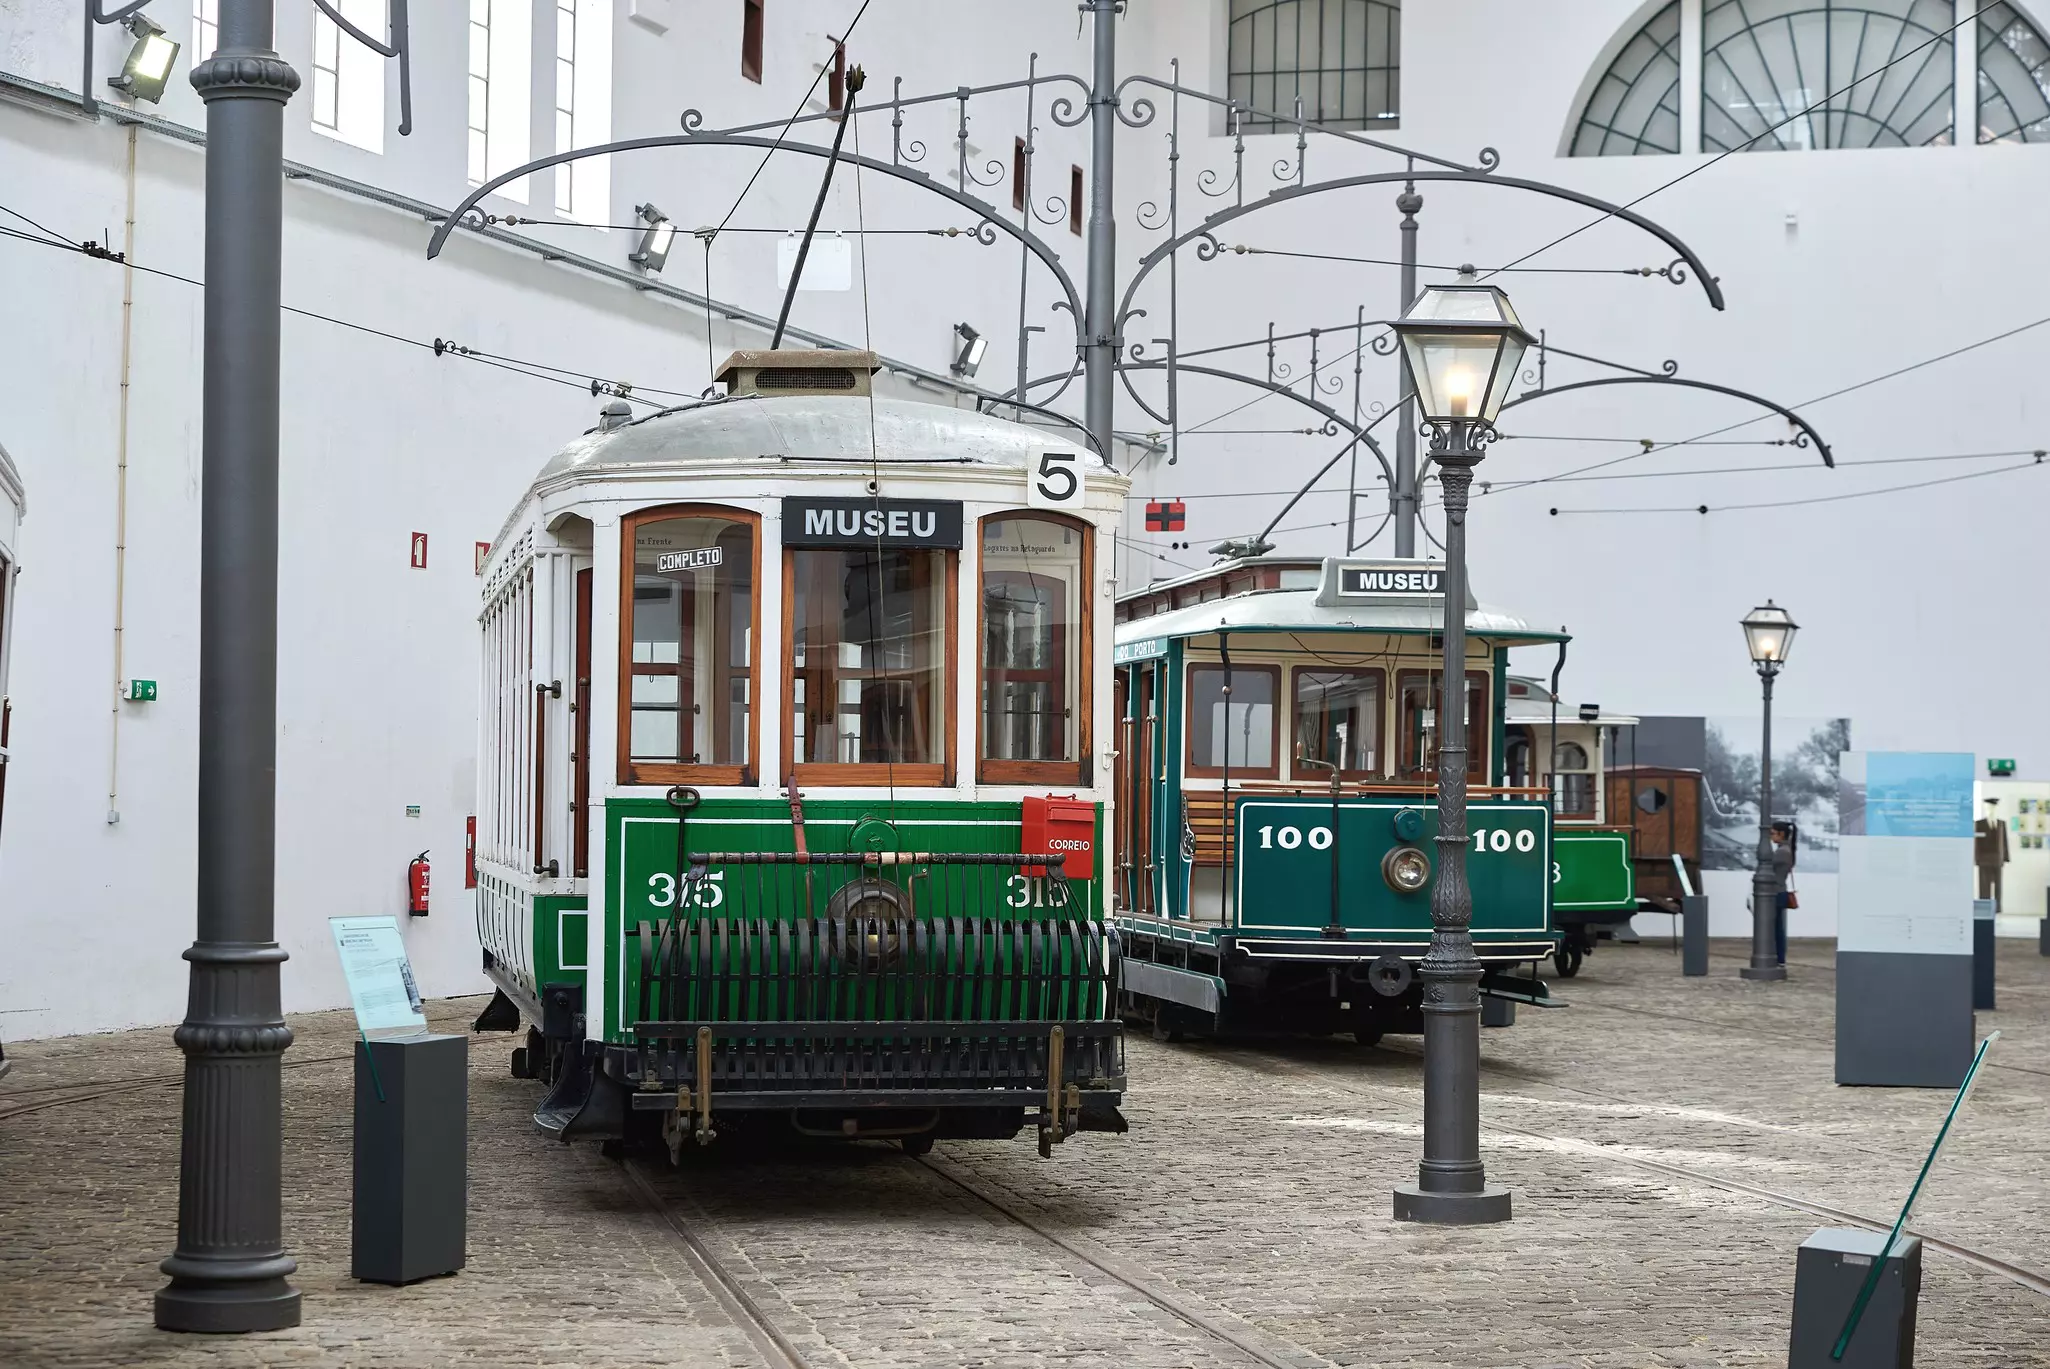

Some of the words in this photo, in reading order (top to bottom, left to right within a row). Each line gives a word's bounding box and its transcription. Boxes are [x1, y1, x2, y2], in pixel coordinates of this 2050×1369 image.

[1036, 453, 1077, 501] 5
[804, 509, 936, 537] MUSEU
[659, 548, 720, 570] COMPLETO
[1360, 572, 1438, 590] MUSEU
[1134, 640, 1156, 657] PORTO
[1049, 839, 1090, 851] CORREIO
[1258, 825, 1333, 850] 100
[1473, 829, 1535, 852] 100
